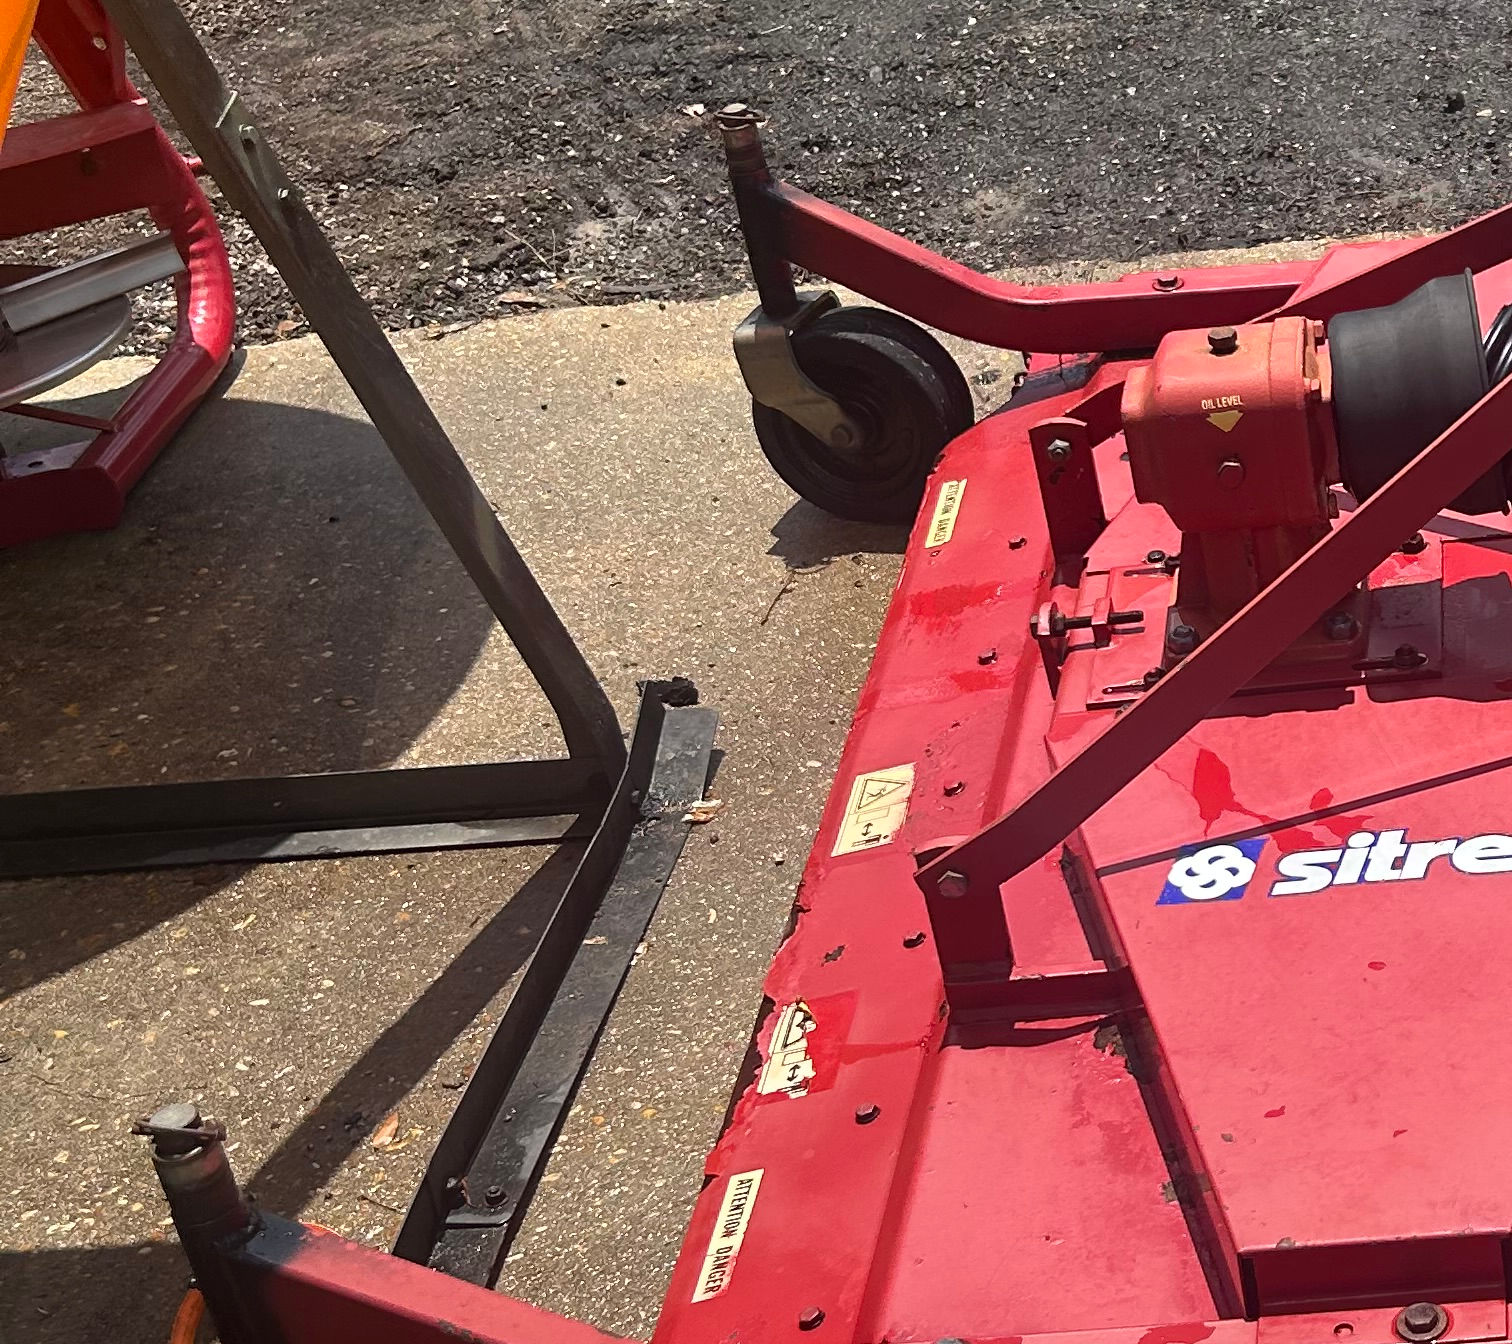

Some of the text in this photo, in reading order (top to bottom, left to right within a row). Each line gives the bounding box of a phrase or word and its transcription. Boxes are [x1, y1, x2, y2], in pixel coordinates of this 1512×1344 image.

[1201, 394, 1244, 410] OIL LEVEL
[703, 1178, 754, 1295] ATTENTION DANGER
